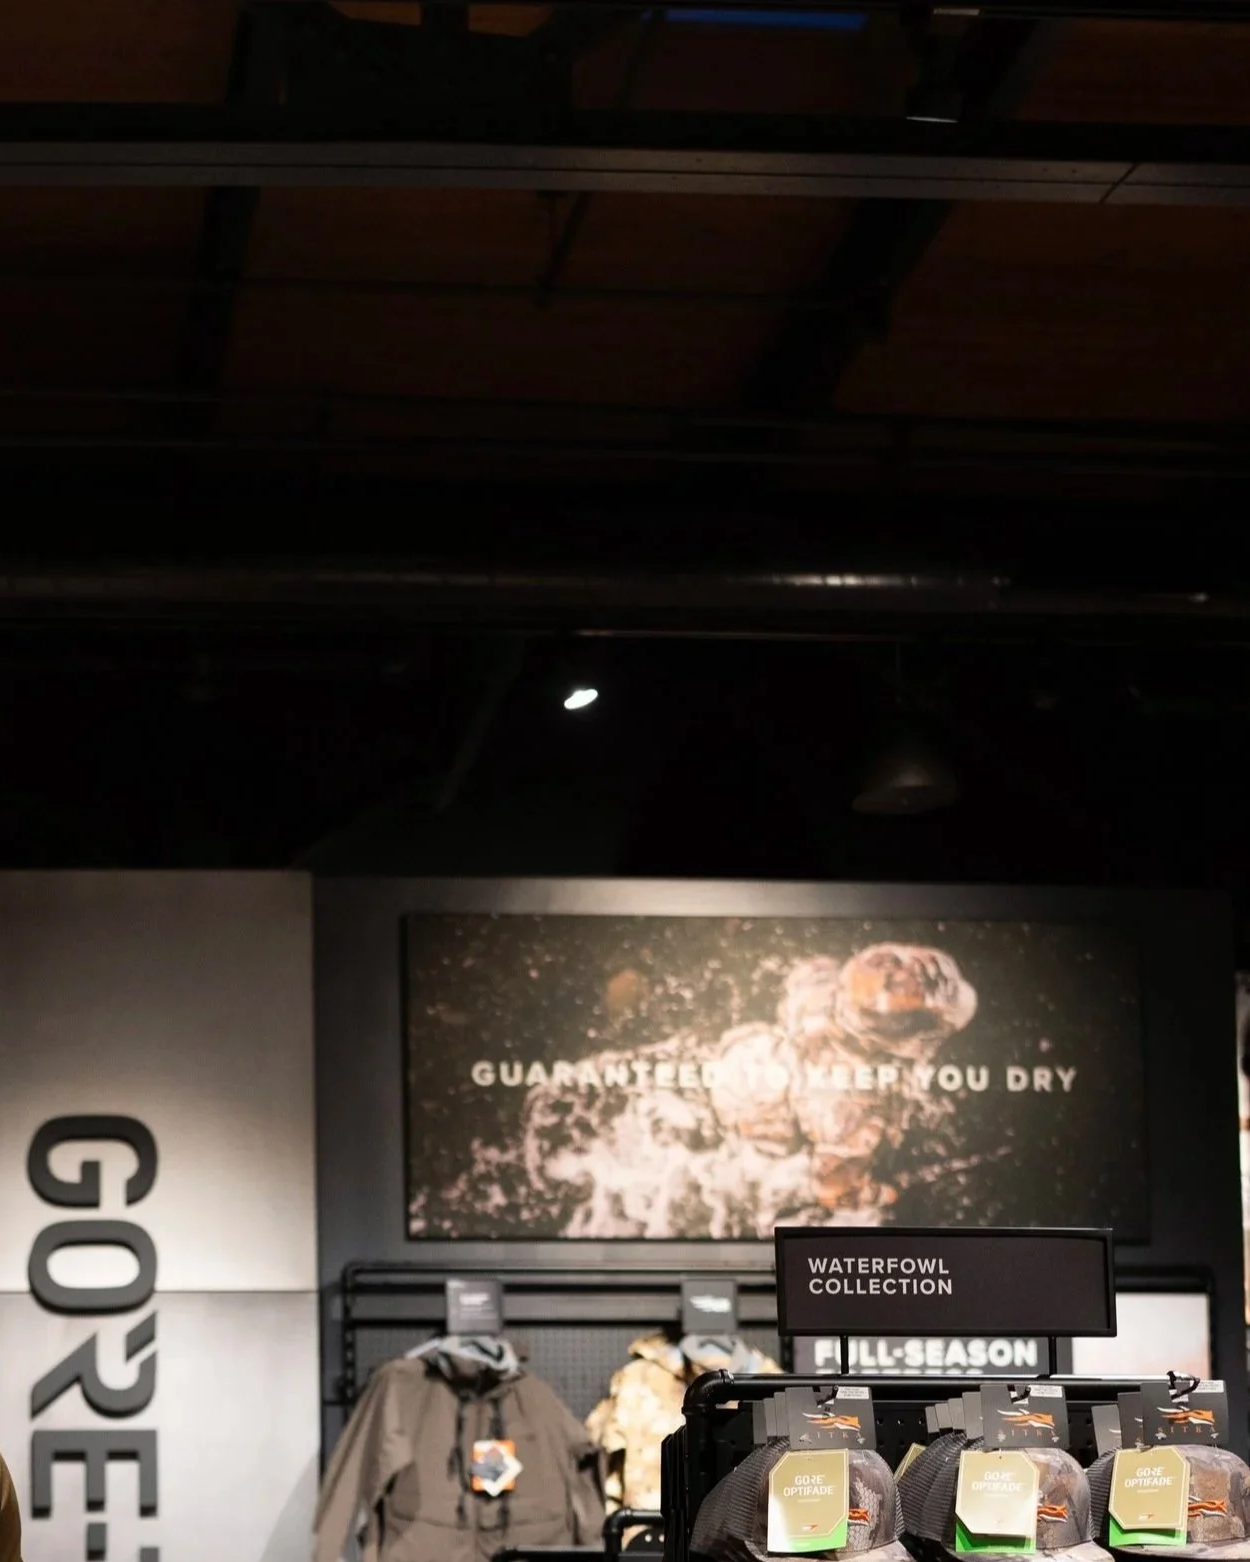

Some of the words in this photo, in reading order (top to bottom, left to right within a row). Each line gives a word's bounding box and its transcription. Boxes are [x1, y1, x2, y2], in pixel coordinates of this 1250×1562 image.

[470, 1060, 720, 1089] GUARANTEED
[744, 1064, 790, 1091] TO
[807, 1065, 900, 1091] KEEP
[915, 1065, 989, 1092] YOU
[1007, 1066, 1078, 1092] DRY
[808, 1257, 950, 1275] WATERFOWL
[808, 1277, 953, 1296] COLLECTION
[813, 1338, 1039, 1368] FULL-SEASON
[794, 1475, 824, 1486] GORE
[783, 1485, 834, 1497] OPTIFADE
